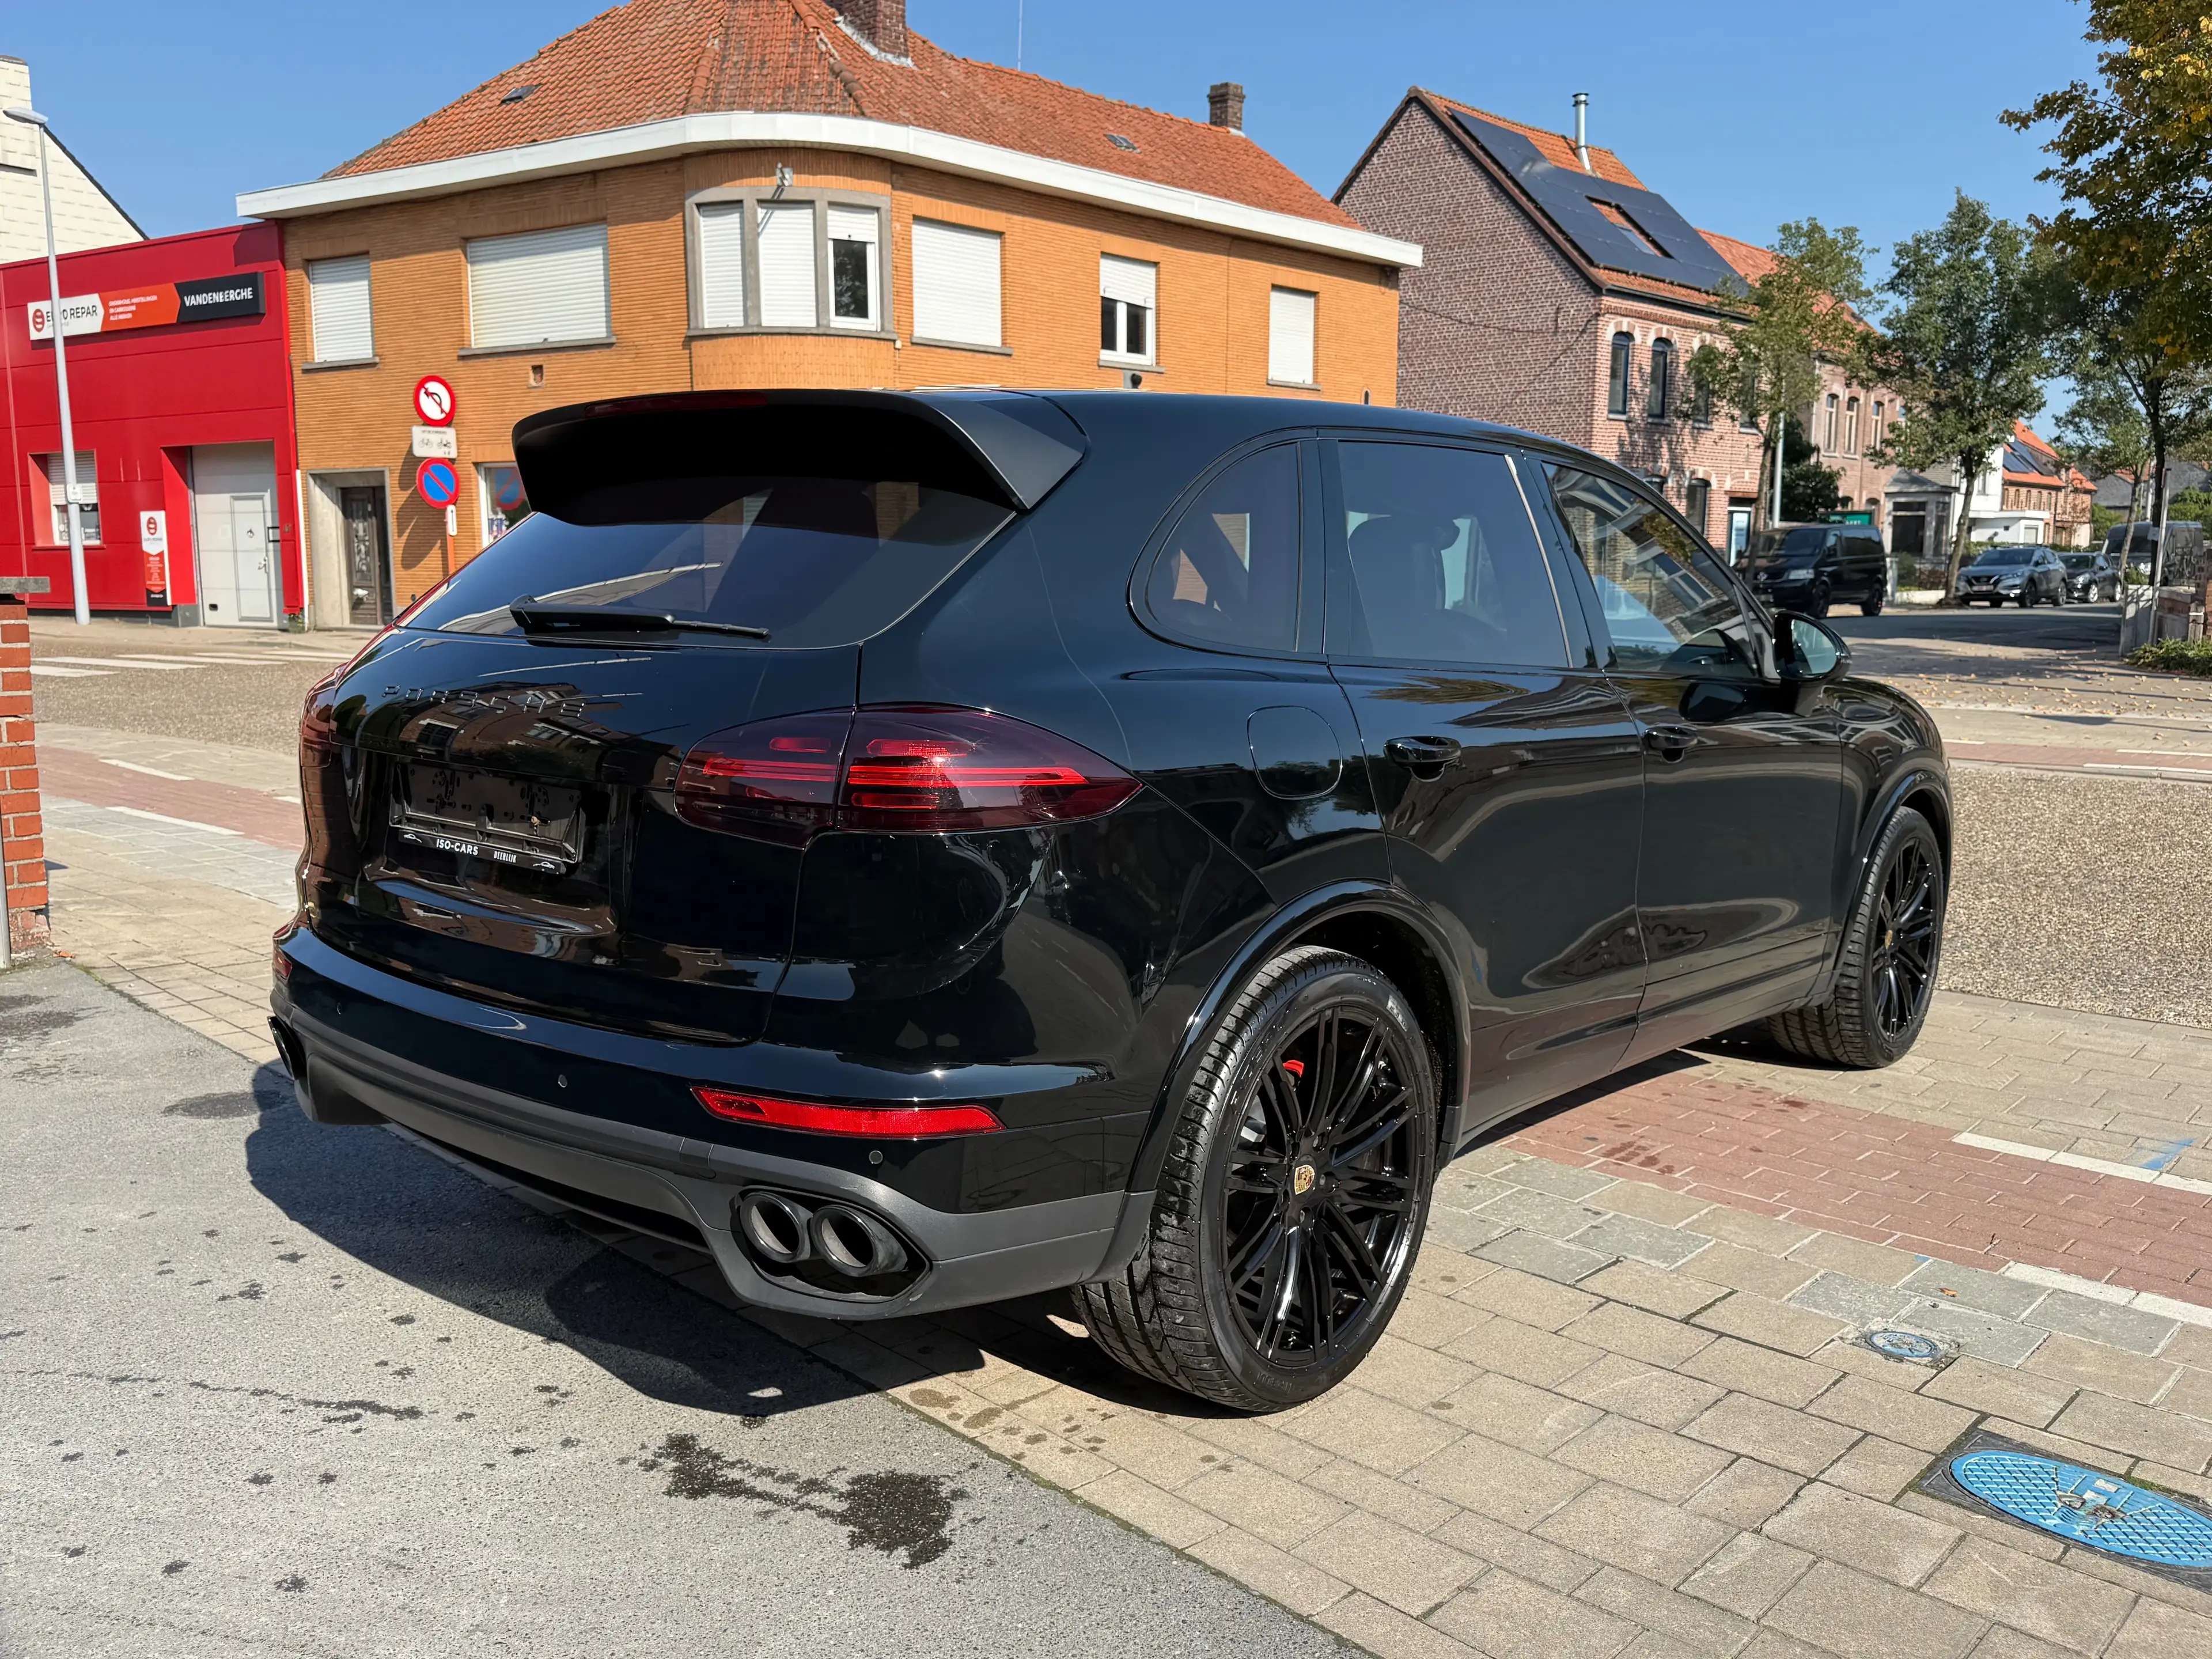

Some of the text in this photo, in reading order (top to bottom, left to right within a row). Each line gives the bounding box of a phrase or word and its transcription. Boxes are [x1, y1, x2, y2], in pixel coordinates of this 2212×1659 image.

[46, 309, 68, 322] EO
[70, 305, 97, 320] REPAR
[381, 684, 586, 718] PORSCHE
[436, 838, 479, 856] ISO-CARS
